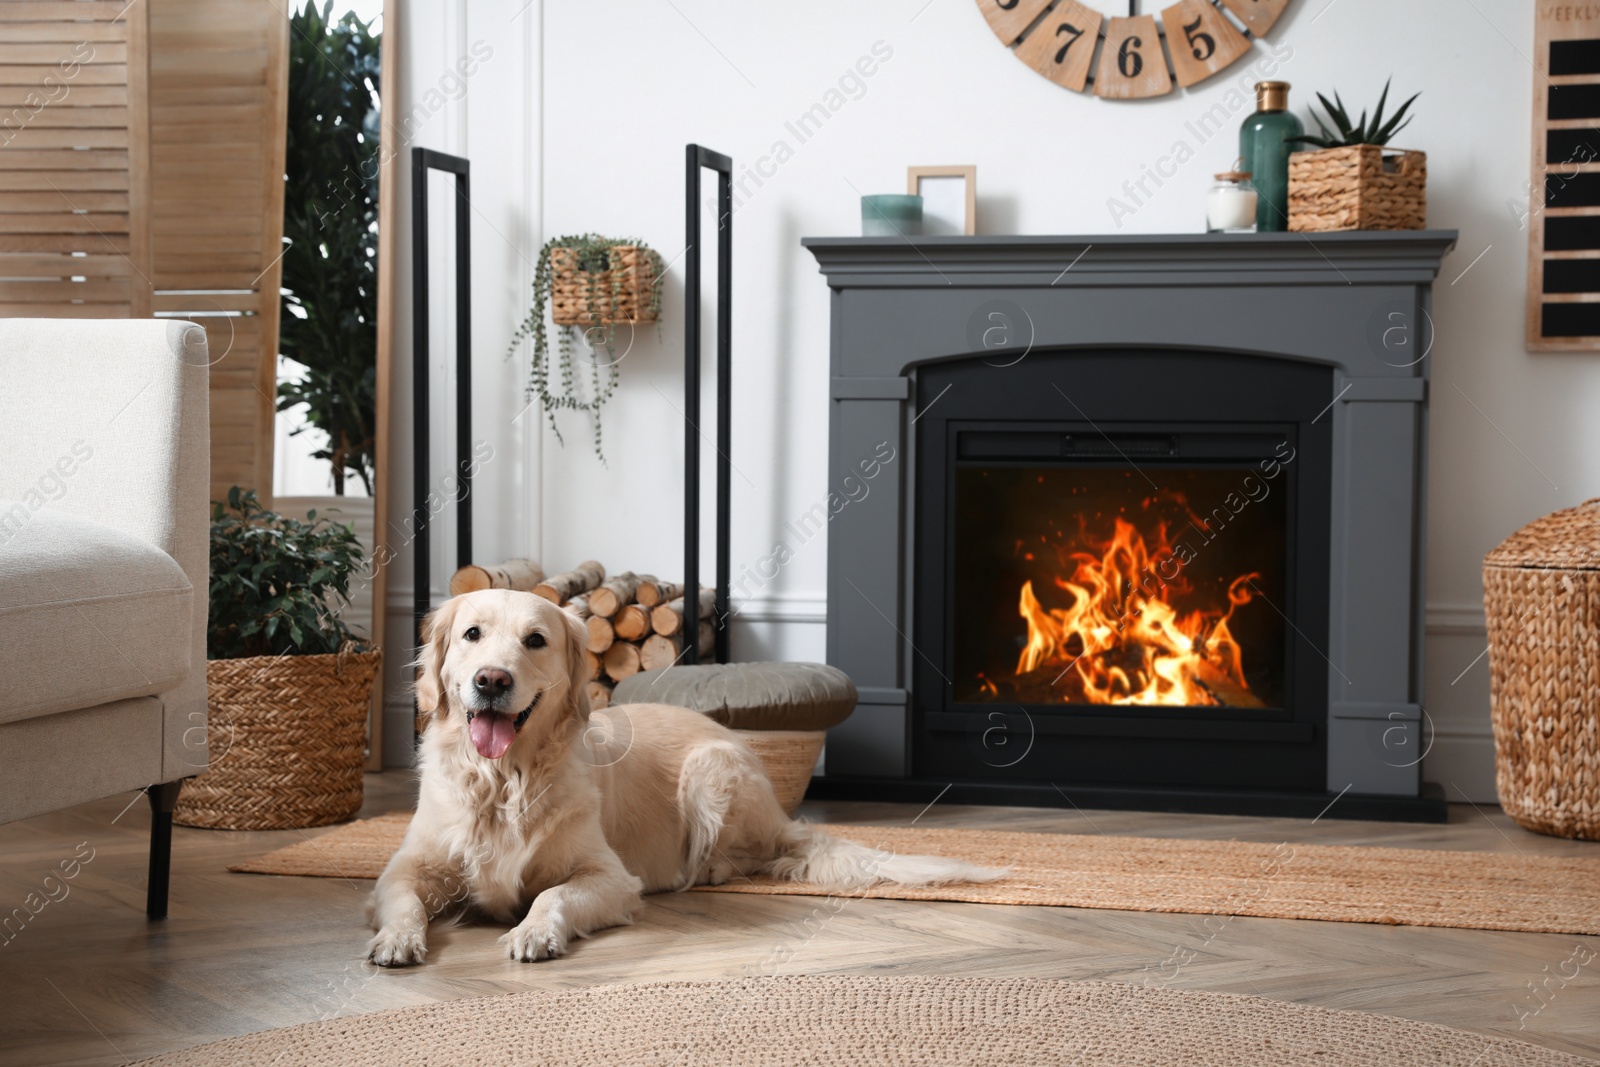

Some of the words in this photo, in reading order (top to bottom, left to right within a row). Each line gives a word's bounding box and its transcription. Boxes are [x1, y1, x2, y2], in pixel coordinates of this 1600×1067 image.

[1055, 22, 1085, 64] 7
[1117, 35, 1143, 78] 6
[1183, 14, 1216, 61] 5
